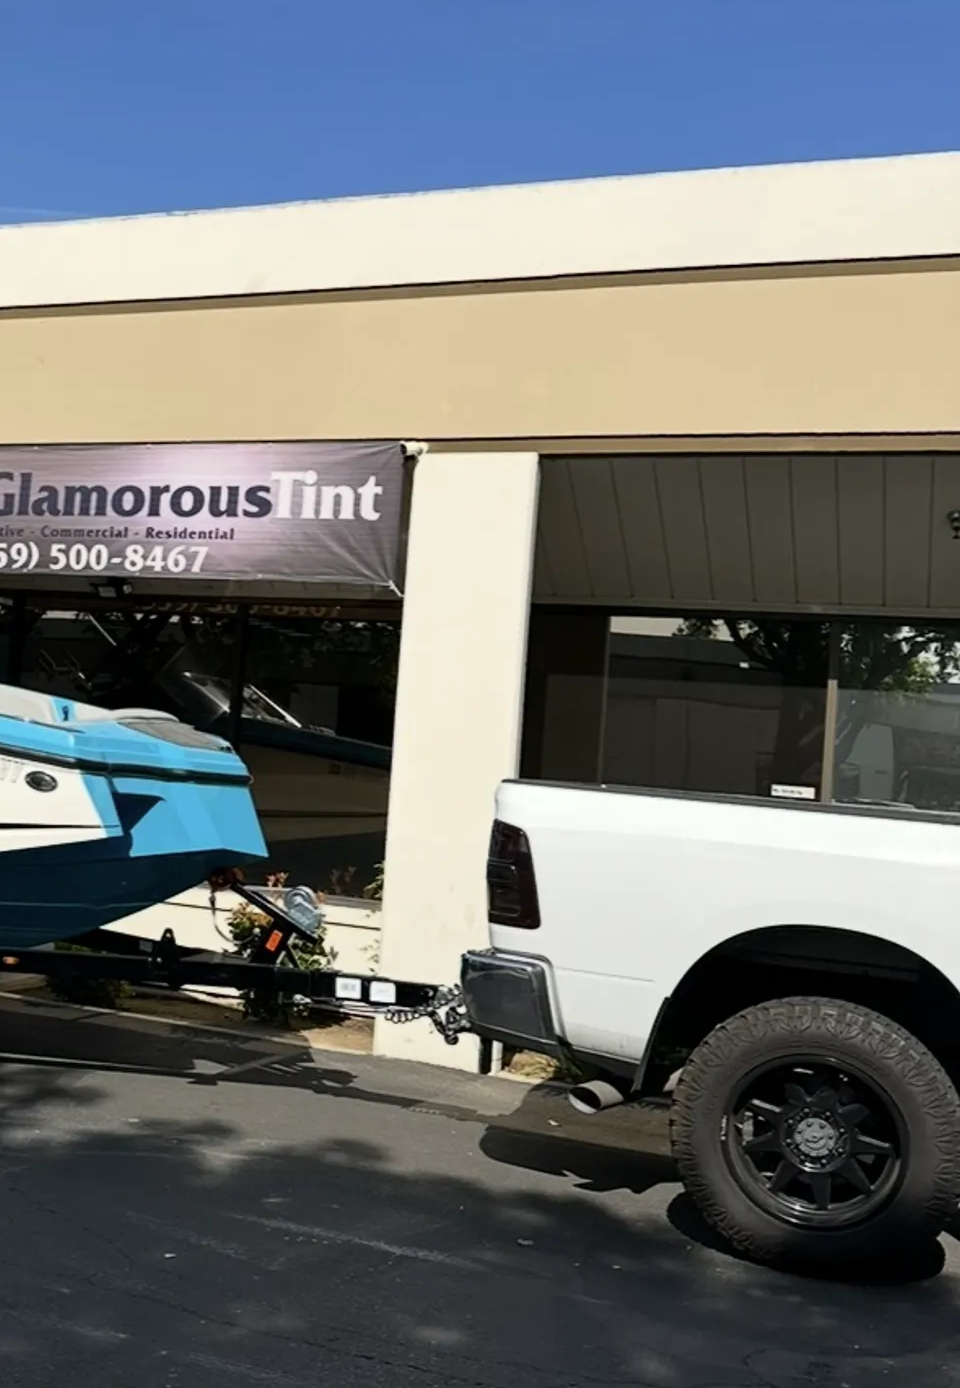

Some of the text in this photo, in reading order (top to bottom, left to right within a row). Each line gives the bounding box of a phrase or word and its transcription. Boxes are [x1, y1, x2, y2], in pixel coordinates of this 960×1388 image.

[40, 525, 129, 539] Commercial
[145, 526, 235, 541] Residential
[49, 543, 209, 573] 500-8467
